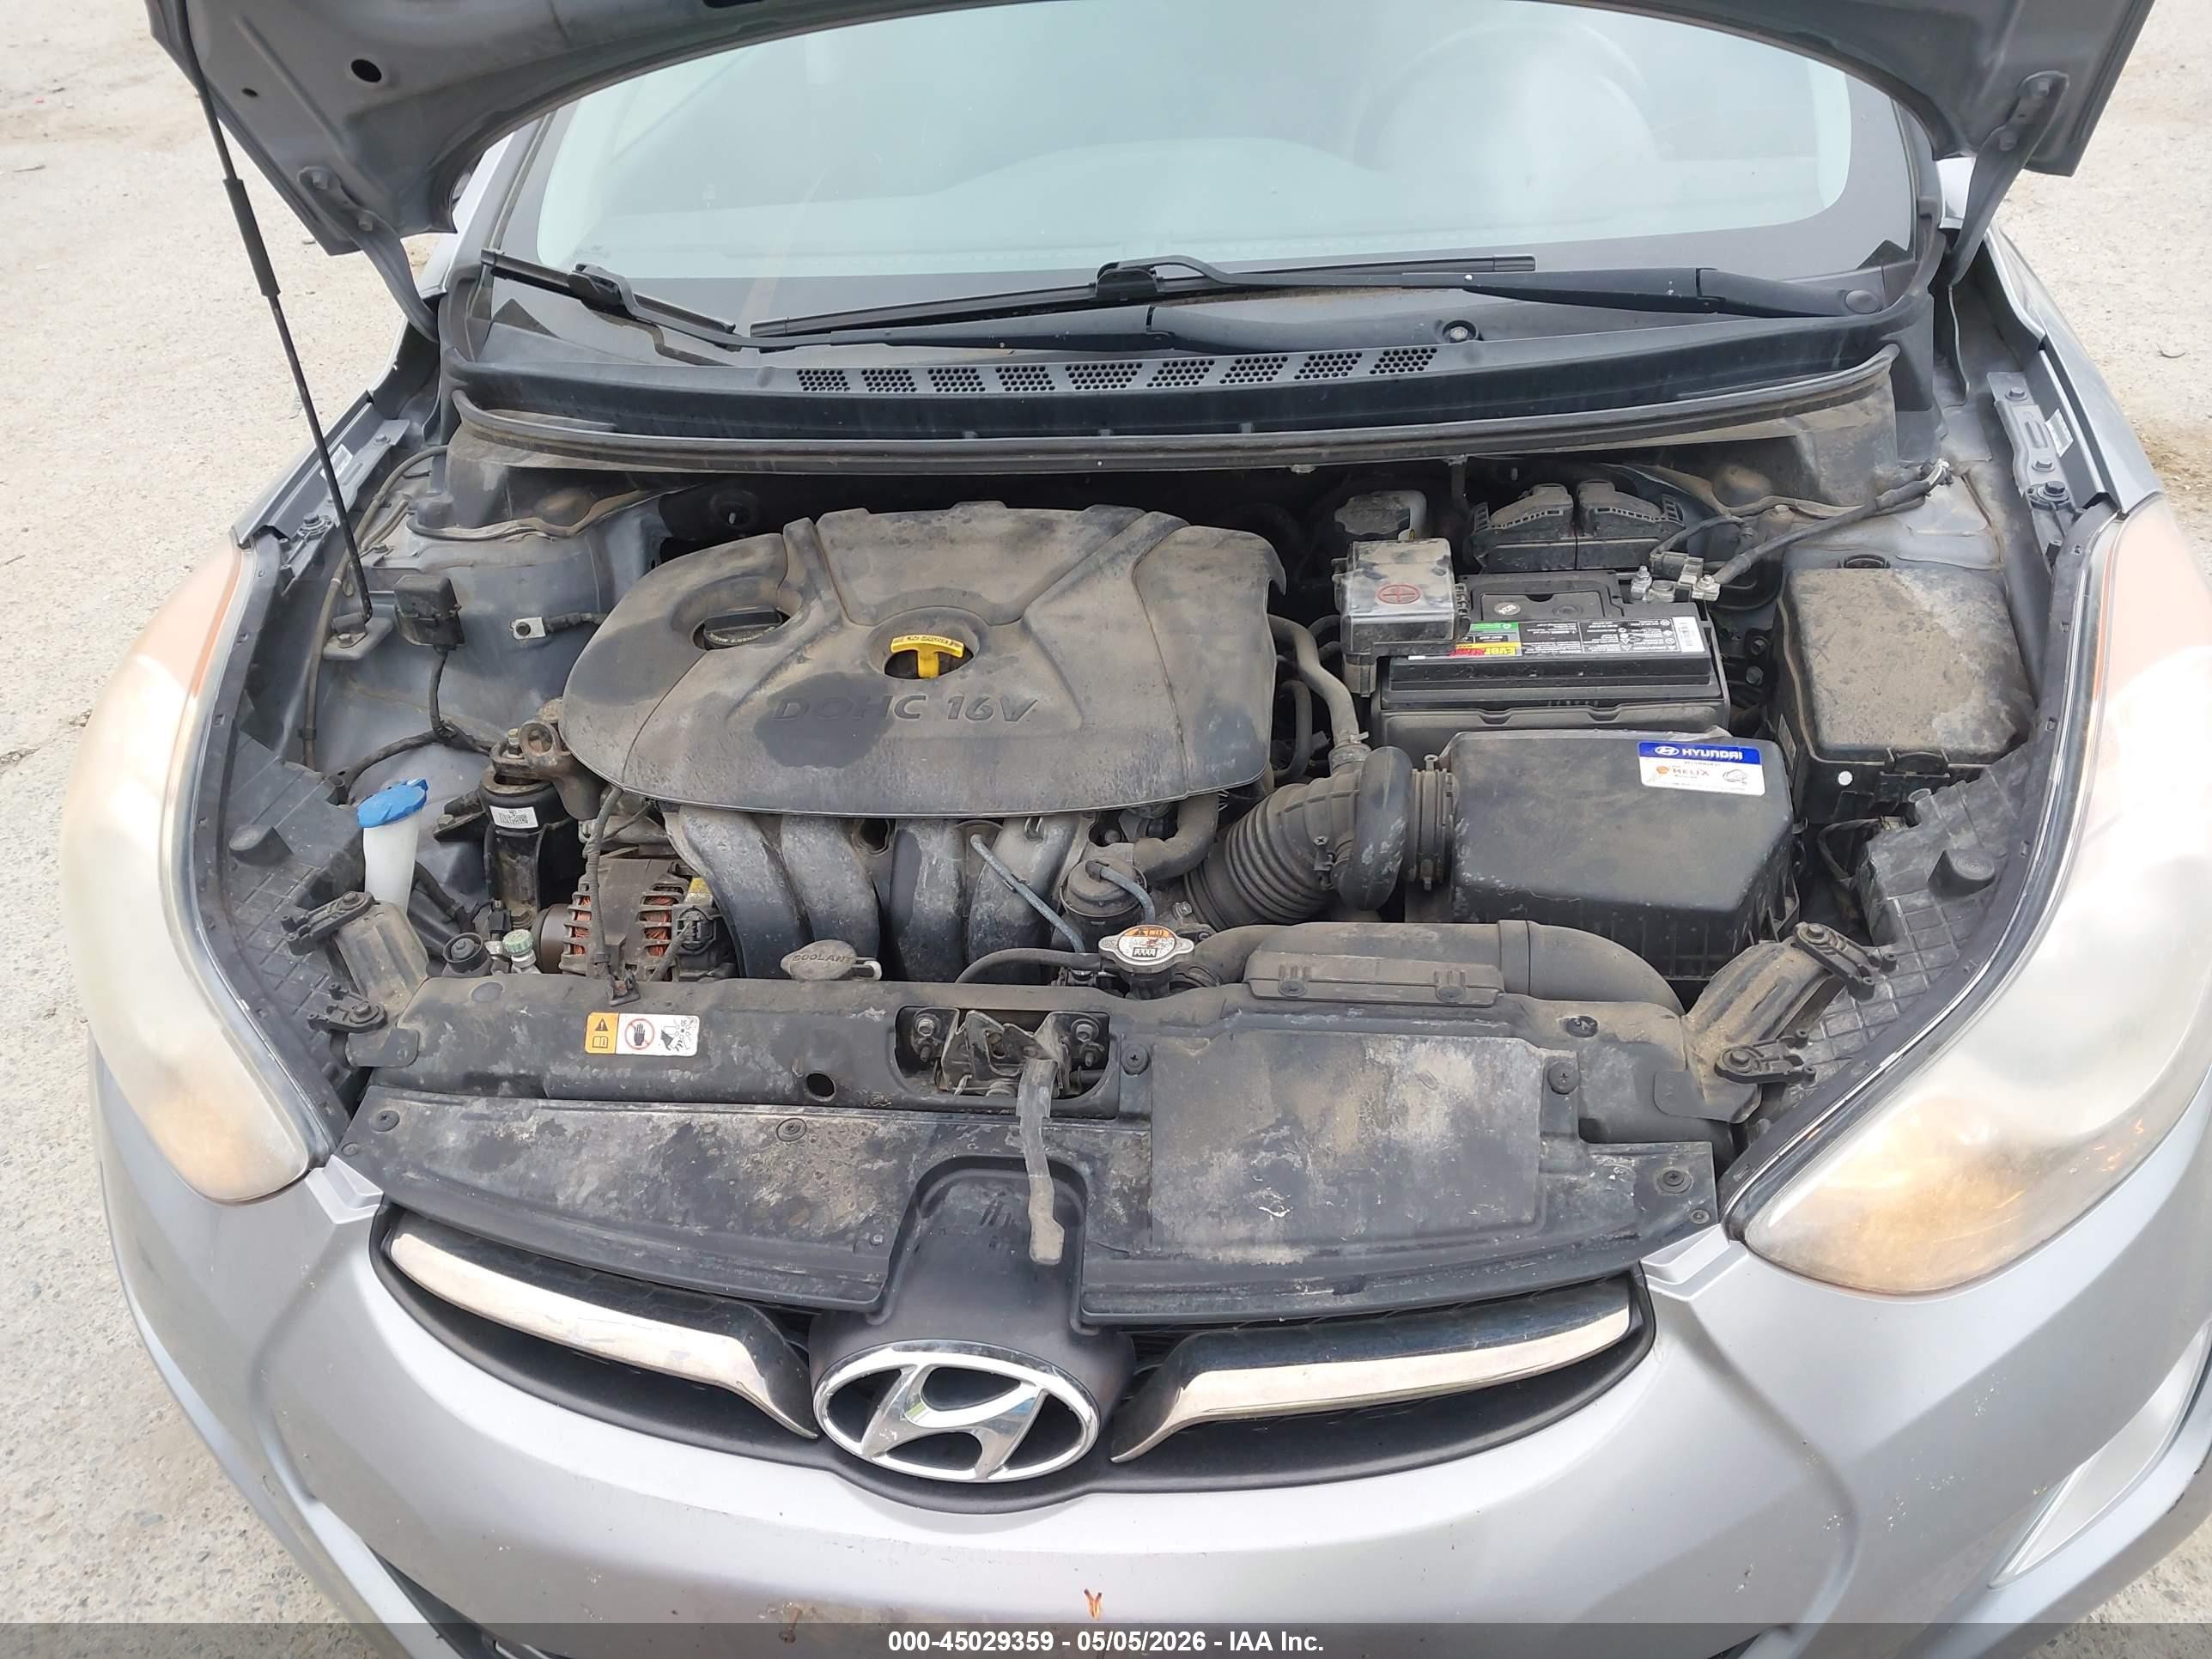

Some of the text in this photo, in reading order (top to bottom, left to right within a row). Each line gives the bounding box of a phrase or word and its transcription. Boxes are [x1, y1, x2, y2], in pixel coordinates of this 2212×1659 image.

[774, 694, 1038, 723] DOHC 16V
[1681, 749, 1743, 760] HYUNDAI
[791, 953, 854, 963] COOLANT
